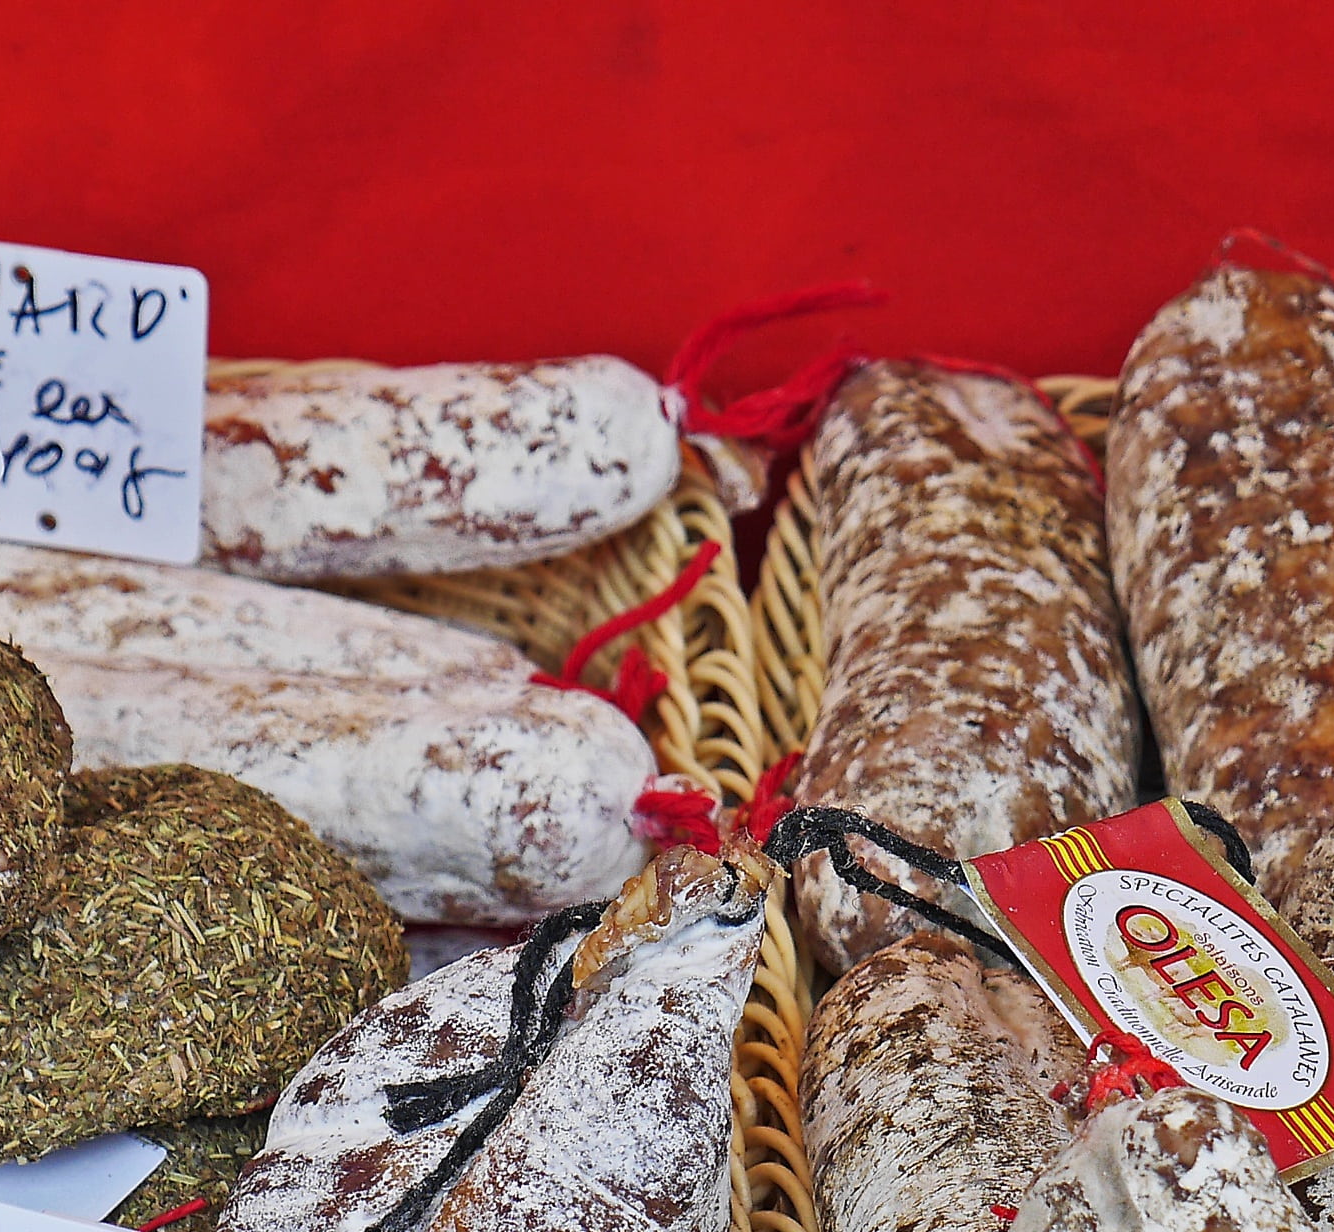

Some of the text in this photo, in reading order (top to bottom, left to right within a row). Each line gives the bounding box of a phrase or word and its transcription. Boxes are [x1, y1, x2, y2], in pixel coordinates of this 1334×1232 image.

[1097, 972, 1185, 1064] Traditionnelle
[1182, 1063, 1279, 1099] Artisanale
[1115, 904, 1273, 1072] OLESA
[1118, 875, 1322, 1089] SPECIALITES CATALANES
[1193, 931, 1265, 1007] Salaisons
